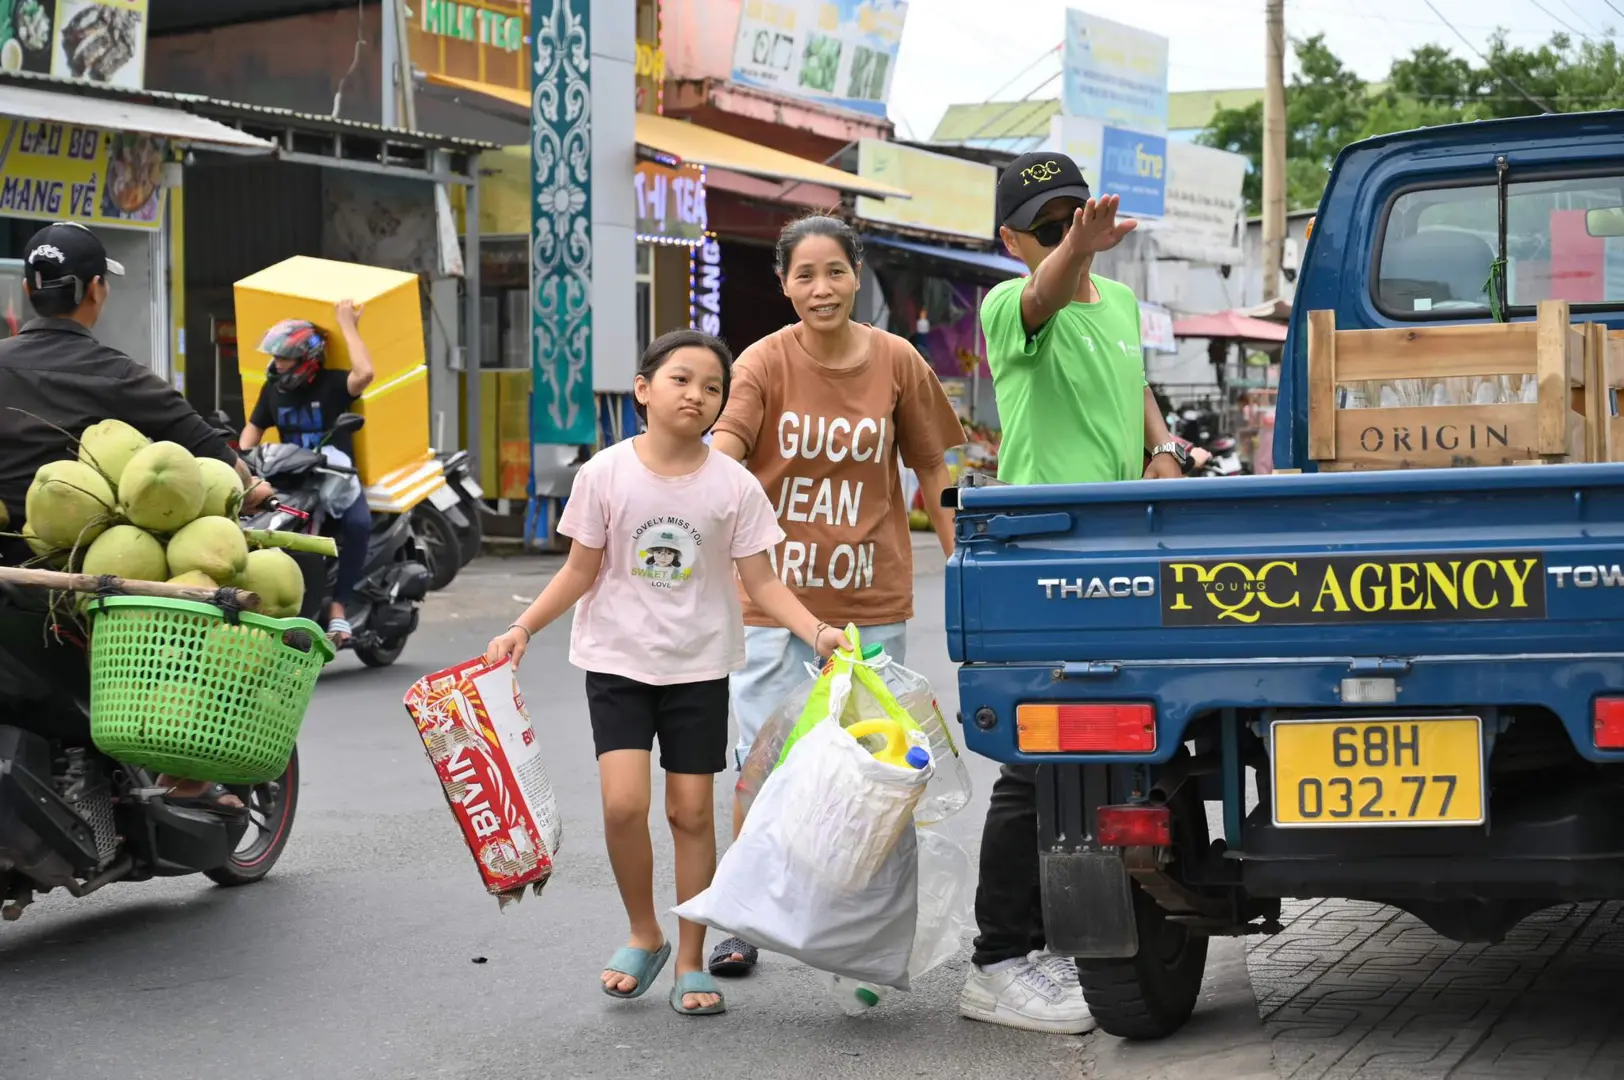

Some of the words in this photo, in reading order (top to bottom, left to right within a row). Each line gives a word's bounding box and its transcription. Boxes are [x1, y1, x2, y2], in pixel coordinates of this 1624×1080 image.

[420, 0, 475, 41] MILK
[476, 8, 522, 53] TEA
[1, 175, 64, 213] MANG
[672, 176, 708, 224] TEA
[778, 411, 886, 463] GUCCI
[1360, 424, 1508, 452] ORIGIN
[774, 476, 864, 527] JEAN
[632, 516, 664, 540] LOVELY
[667, 516, 690, 530] MISS
[690, 528, 703, 546] YOU
[1038, 576, 1154, 599] THACO
[1169, 561, 1299, 623] PQC
[1312, 558, 1537, 612] AGENCY
[1202, 582, 1266, 592] YOUNG
[1332, 725, 1419, 767] 68H
[1298, 775, 1457, 818] 032.77
